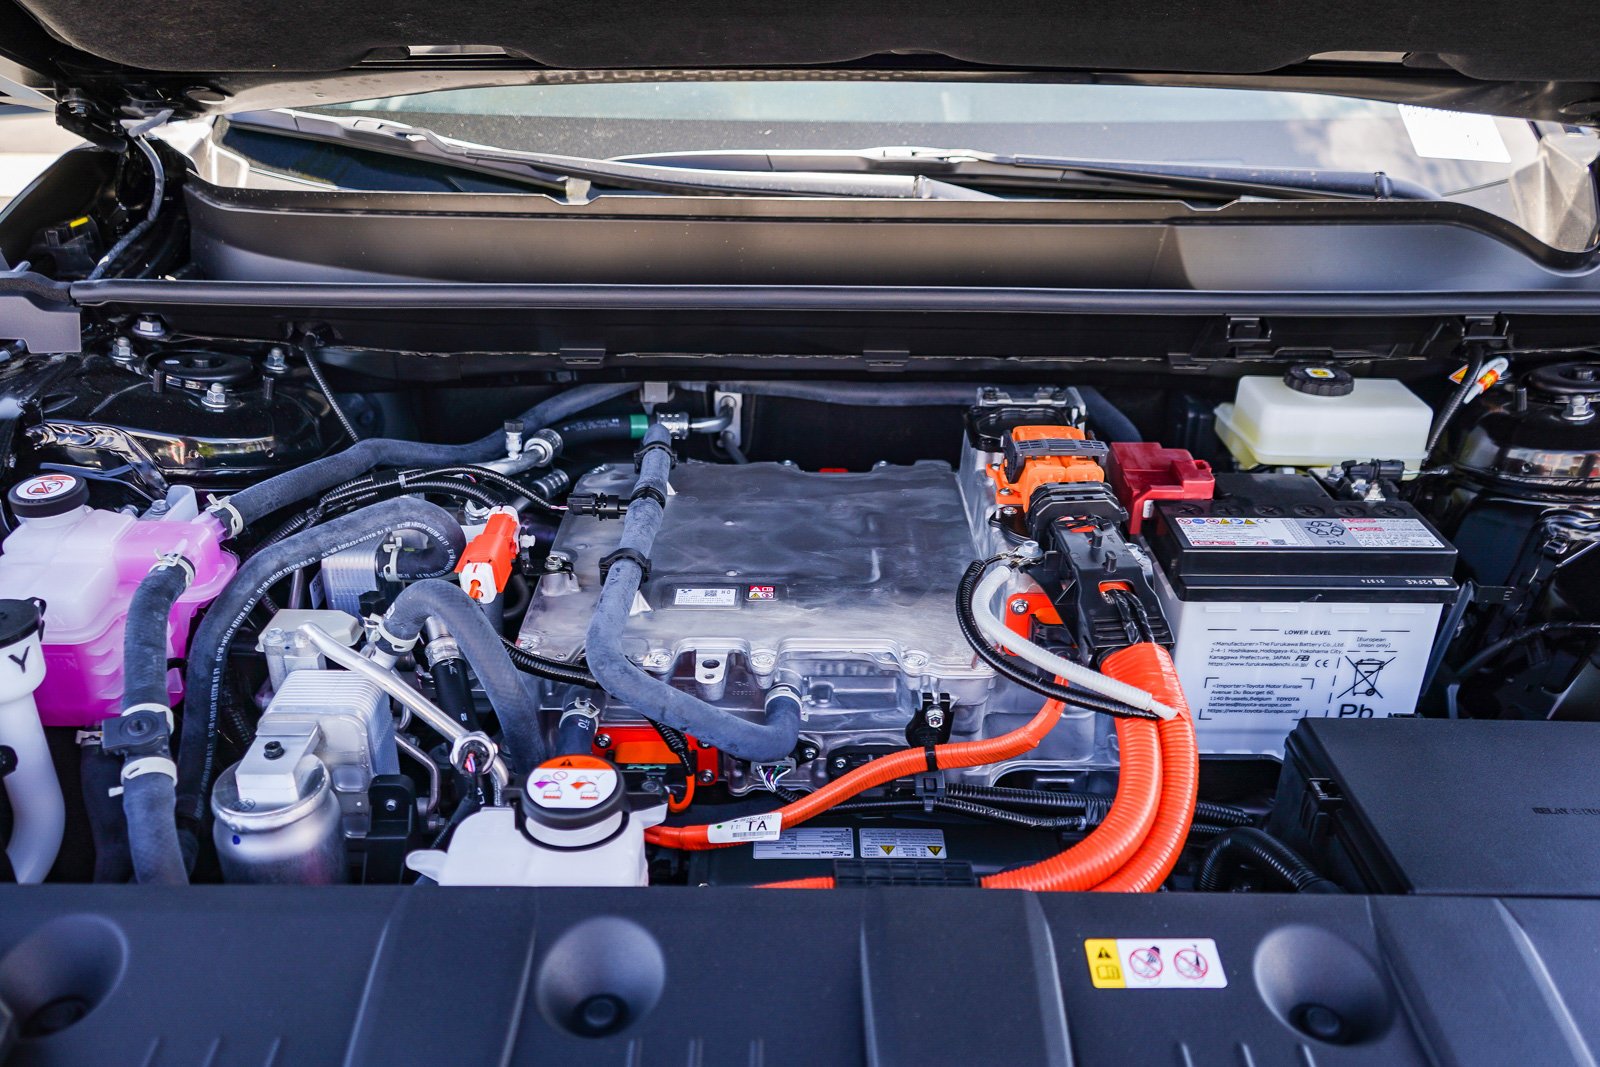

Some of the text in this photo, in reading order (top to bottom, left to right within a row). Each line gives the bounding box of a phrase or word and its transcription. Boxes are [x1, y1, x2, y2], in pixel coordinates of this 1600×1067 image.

[8, 646, 30, 674] Y
[1339, 704, 1373, 718] Pb
[747, 820, 767, 831] TA
